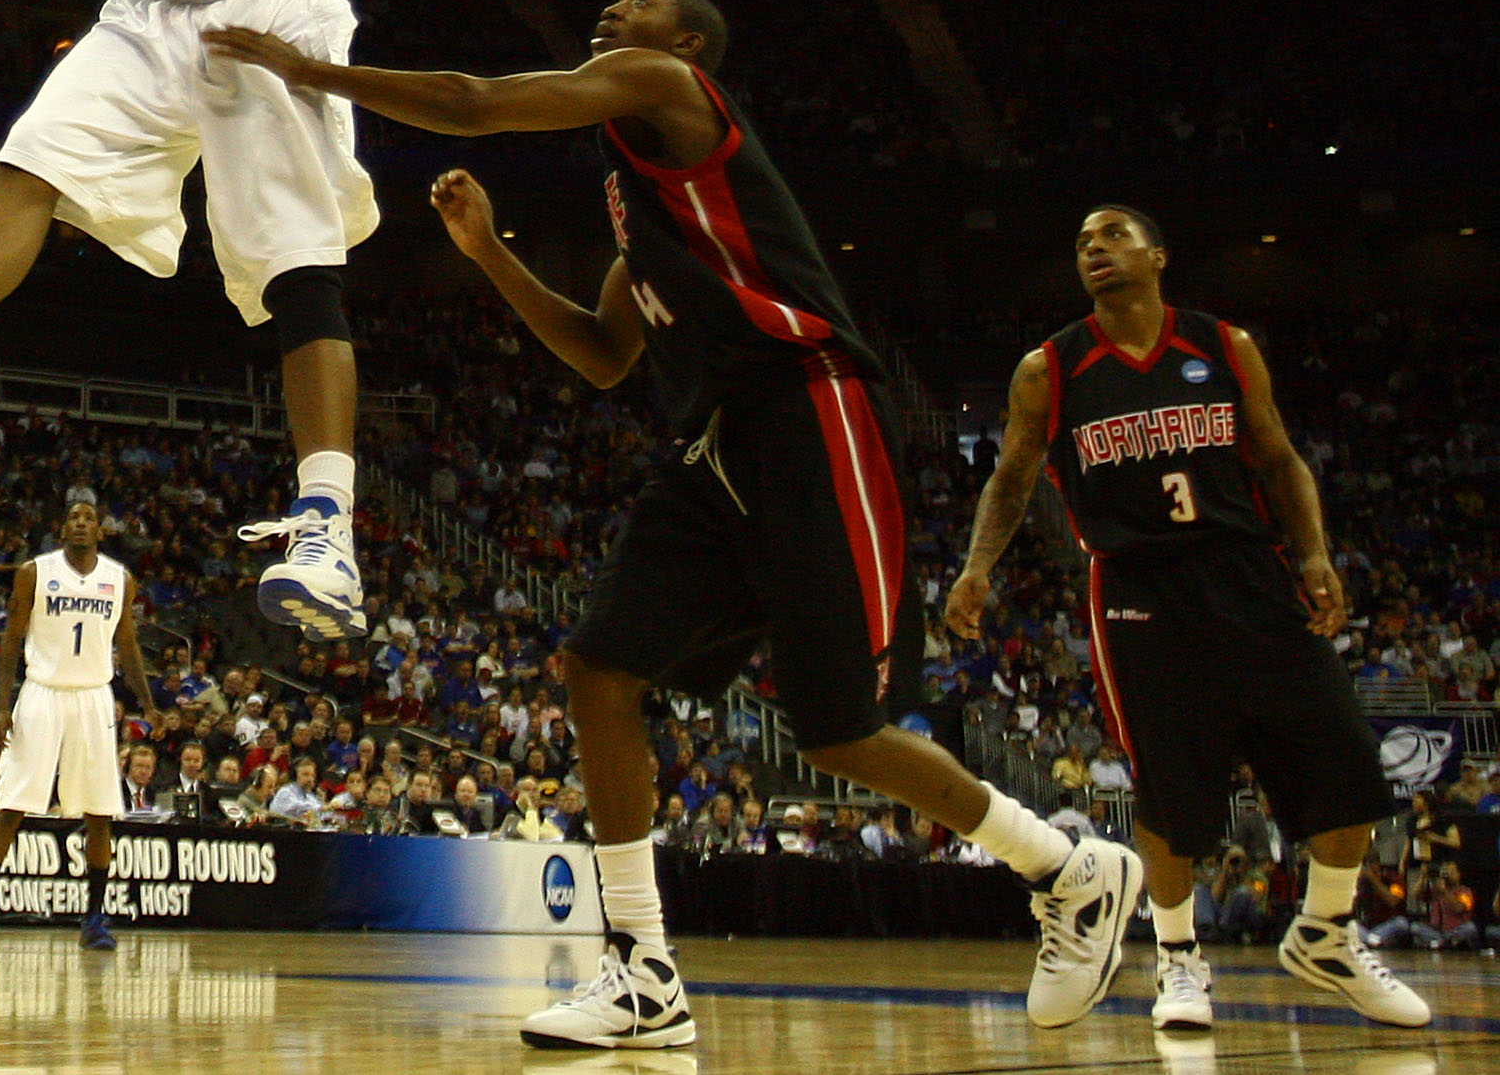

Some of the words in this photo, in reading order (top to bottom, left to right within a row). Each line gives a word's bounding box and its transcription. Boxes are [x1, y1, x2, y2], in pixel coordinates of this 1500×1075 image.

[1071, 402, 1236, 476] NORTHRIDGE
[1160, 471, 1199, 523] 3
[46, 595, 114, 621] MEMPHIS
[72, 621, 83, 657] 1
[177, 838, 278, 885] ROUNDS
[139, 881, 193, 917] HOST
[545, 886, 575, 908] NCAA
